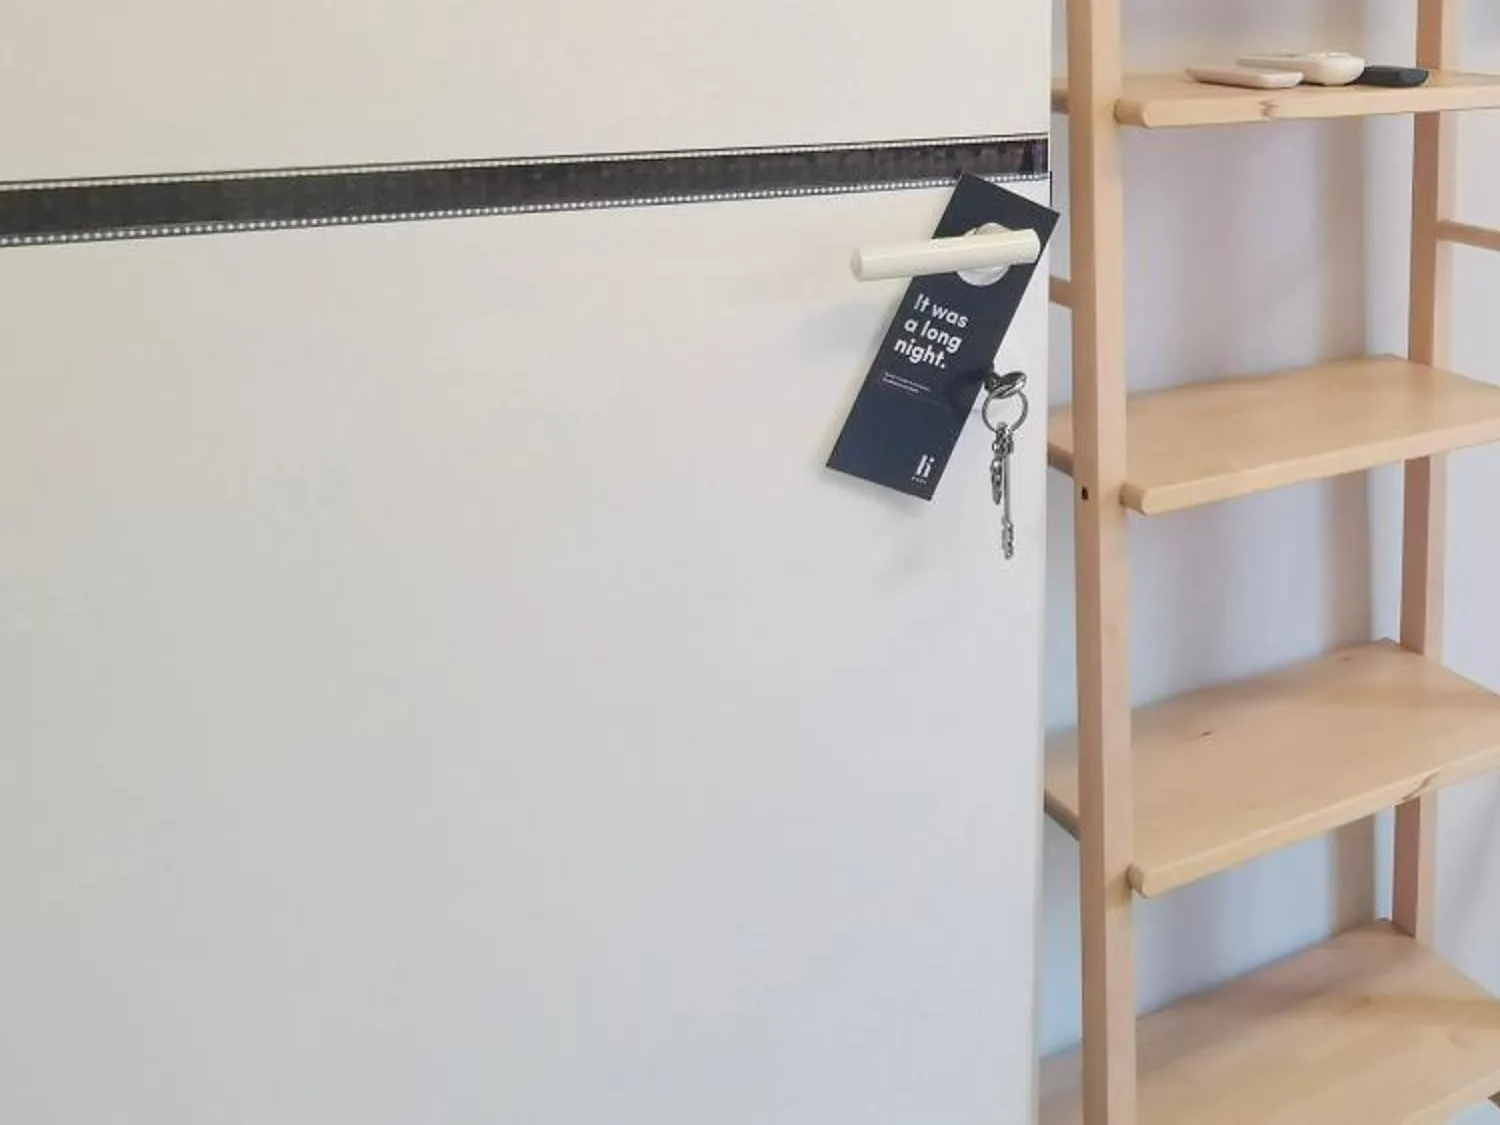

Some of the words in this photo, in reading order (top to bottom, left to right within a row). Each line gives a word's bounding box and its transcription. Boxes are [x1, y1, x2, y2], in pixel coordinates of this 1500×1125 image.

[913, 293, 930, 312] It
[932, 303, 969, 328] was
[893, 339, 945, 369] night.
[904, 319, 918, 333] a
[920, 320, 963, 354] long
